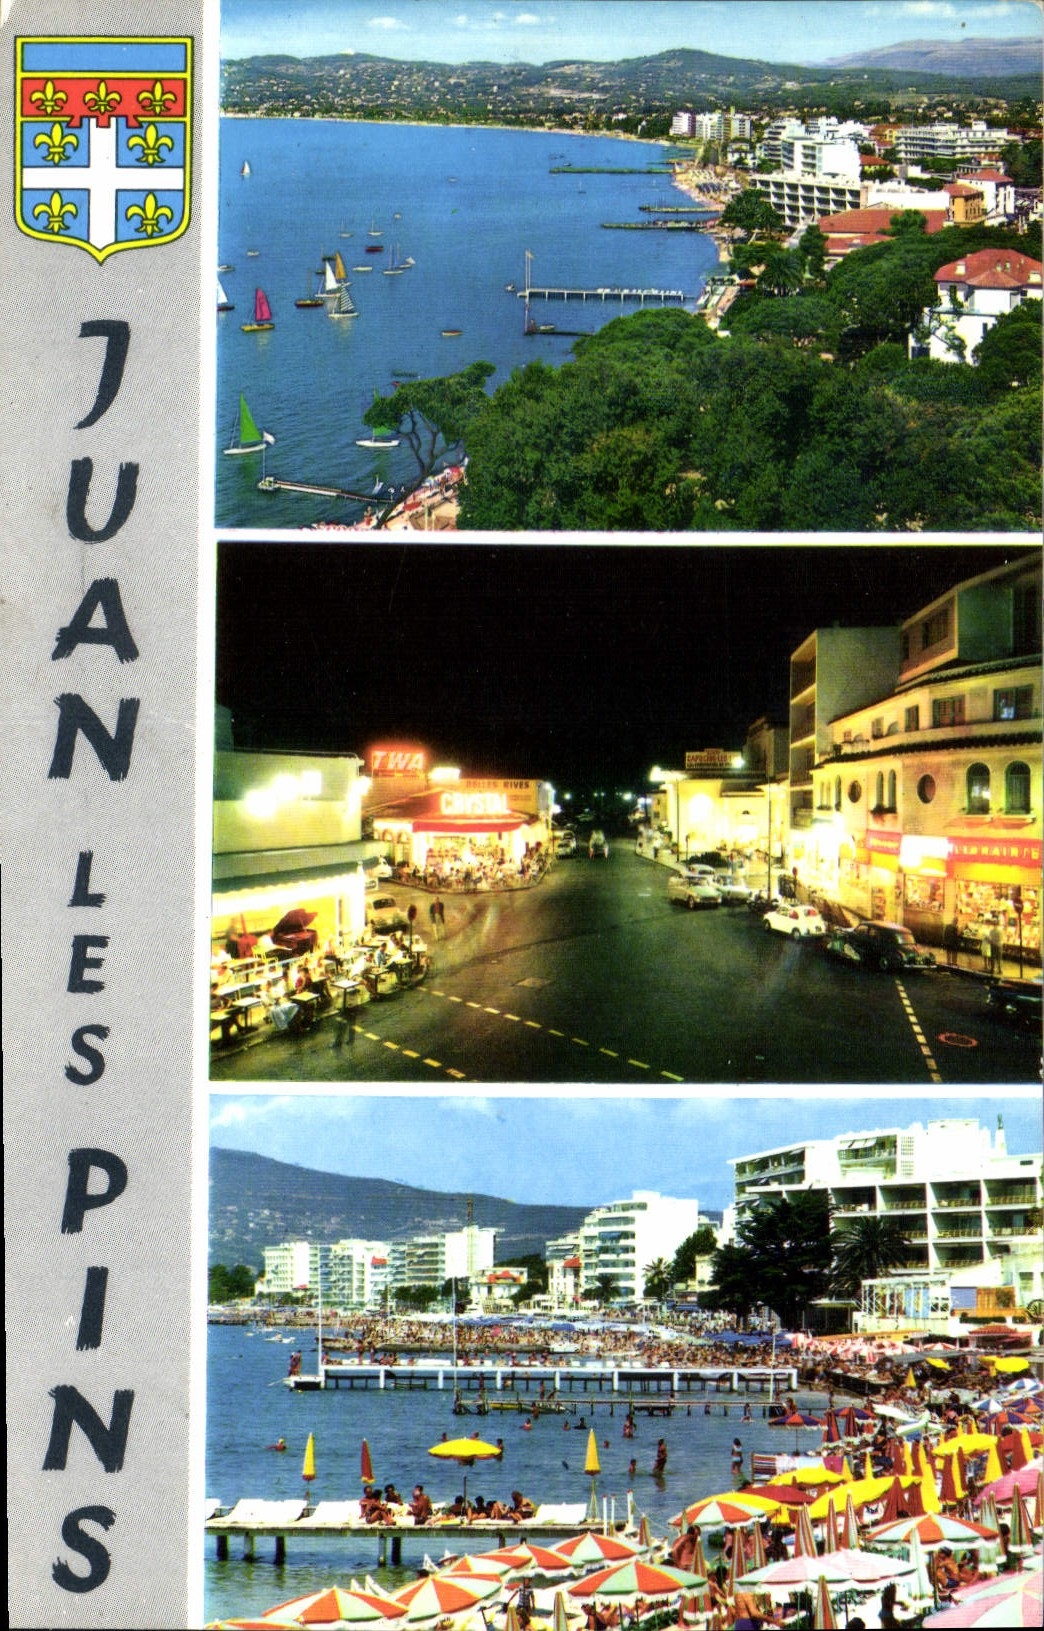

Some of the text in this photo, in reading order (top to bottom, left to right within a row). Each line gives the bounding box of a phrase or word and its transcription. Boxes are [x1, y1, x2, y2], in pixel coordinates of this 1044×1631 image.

[372, 751, 425, 770] TWA
[503, 781, 530, 789] RIVES
[440, 793, 509, 815] CRYSTAL
